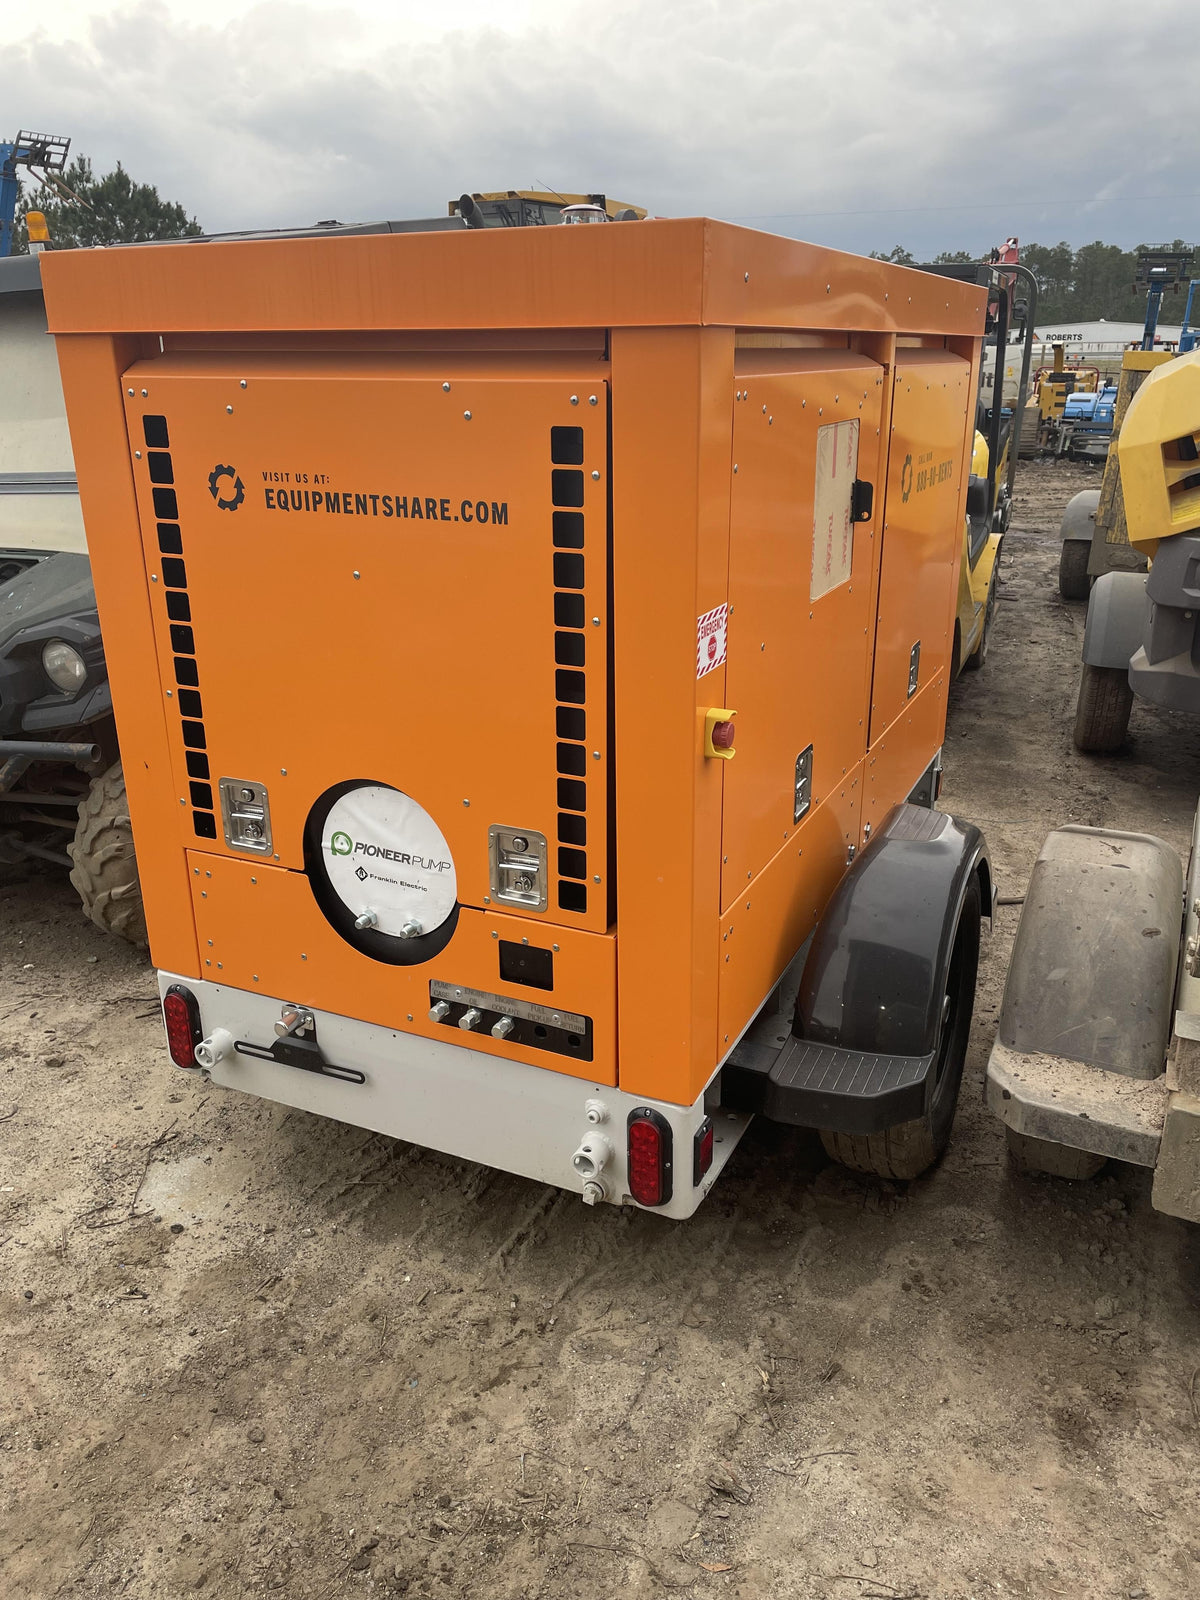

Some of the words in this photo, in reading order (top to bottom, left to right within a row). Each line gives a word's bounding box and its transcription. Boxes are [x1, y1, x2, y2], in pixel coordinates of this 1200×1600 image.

[1045, 333, 1083, 341] ROBERTS
[262, 471, 291, 484] VISIT
[295, 473, 309, 484] US
[314, 474, 331, 485] AT:
[264, 488, 509, 526] EQUIPMENTSHARE.COM
[700, 615, 724, 640] EMERGENCY
[369, 873, 398, 885] Franklin
[399, 880, 428, 892] Electric
